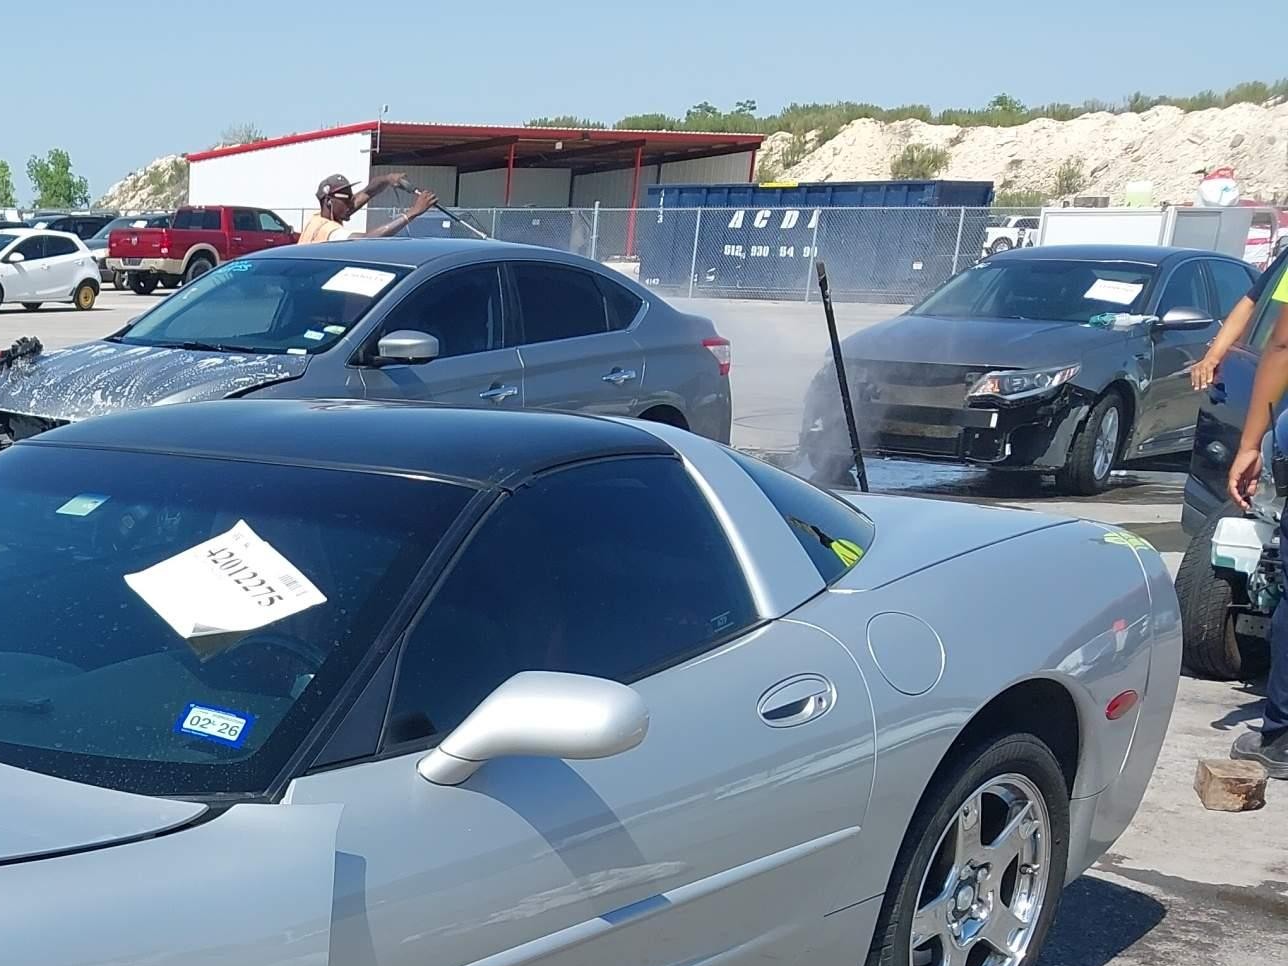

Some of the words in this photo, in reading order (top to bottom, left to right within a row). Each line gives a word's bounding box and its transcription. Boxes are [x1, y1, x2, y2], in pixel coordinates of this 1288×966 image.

[207, 547, 284, 607] 42012275
[189, 715, 211, 729] 02
[217, 722, 240, 737] 26
